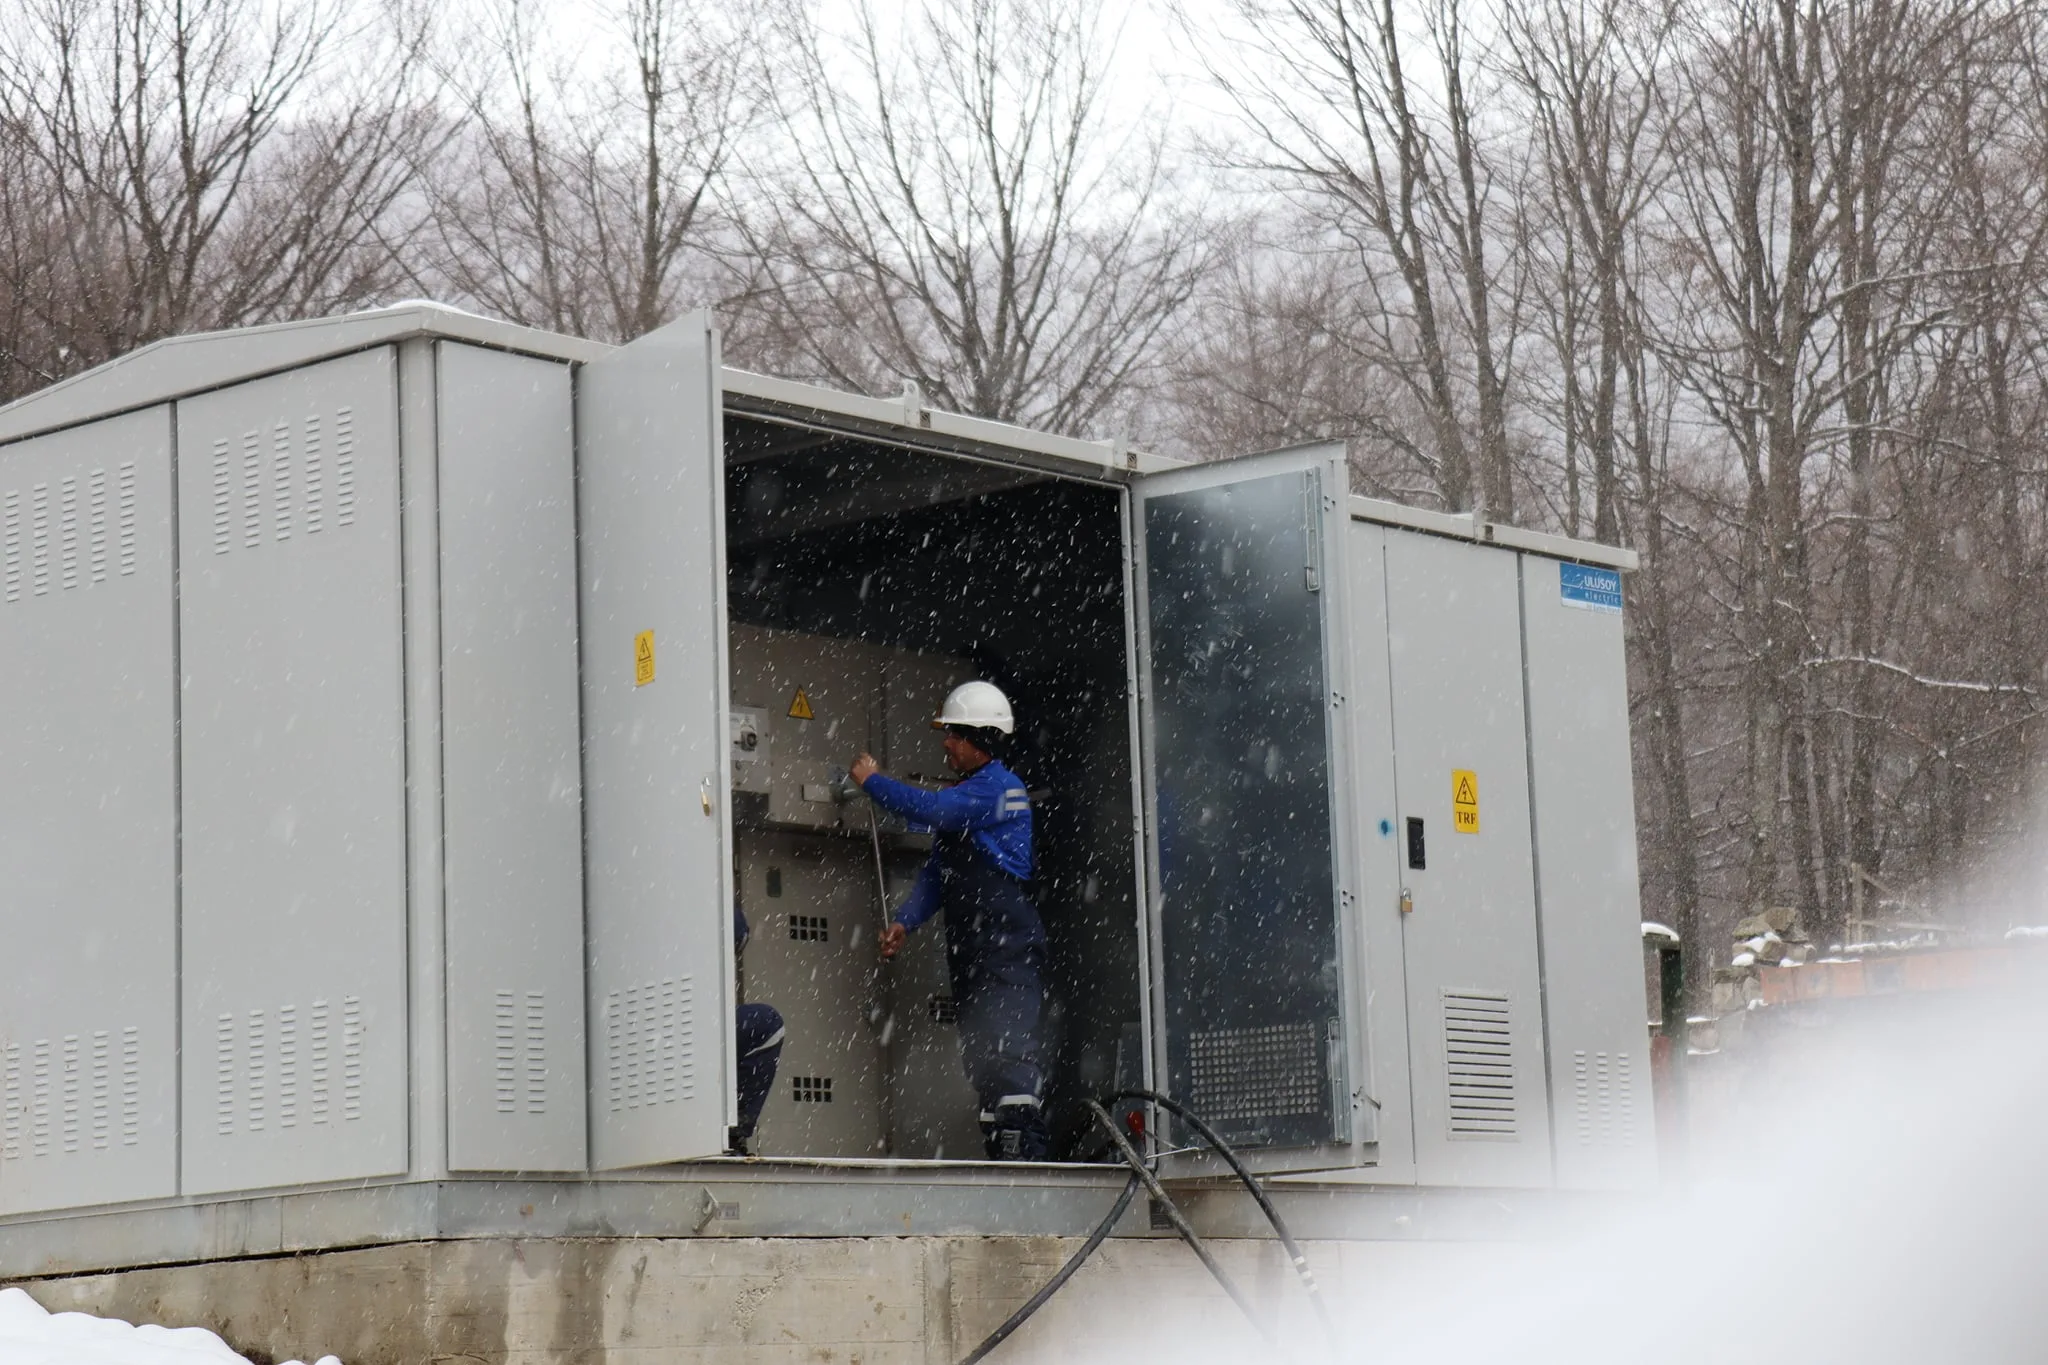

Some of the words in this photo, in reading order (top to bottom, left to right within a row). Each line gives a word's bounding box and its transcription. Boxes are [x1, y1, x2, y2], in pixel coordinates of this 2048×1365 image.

[1584, 575, 1616, 591] ULUSOY
[1585, 591, 1619, 603] electric
[1456, 811, 1476, 824] TRF
